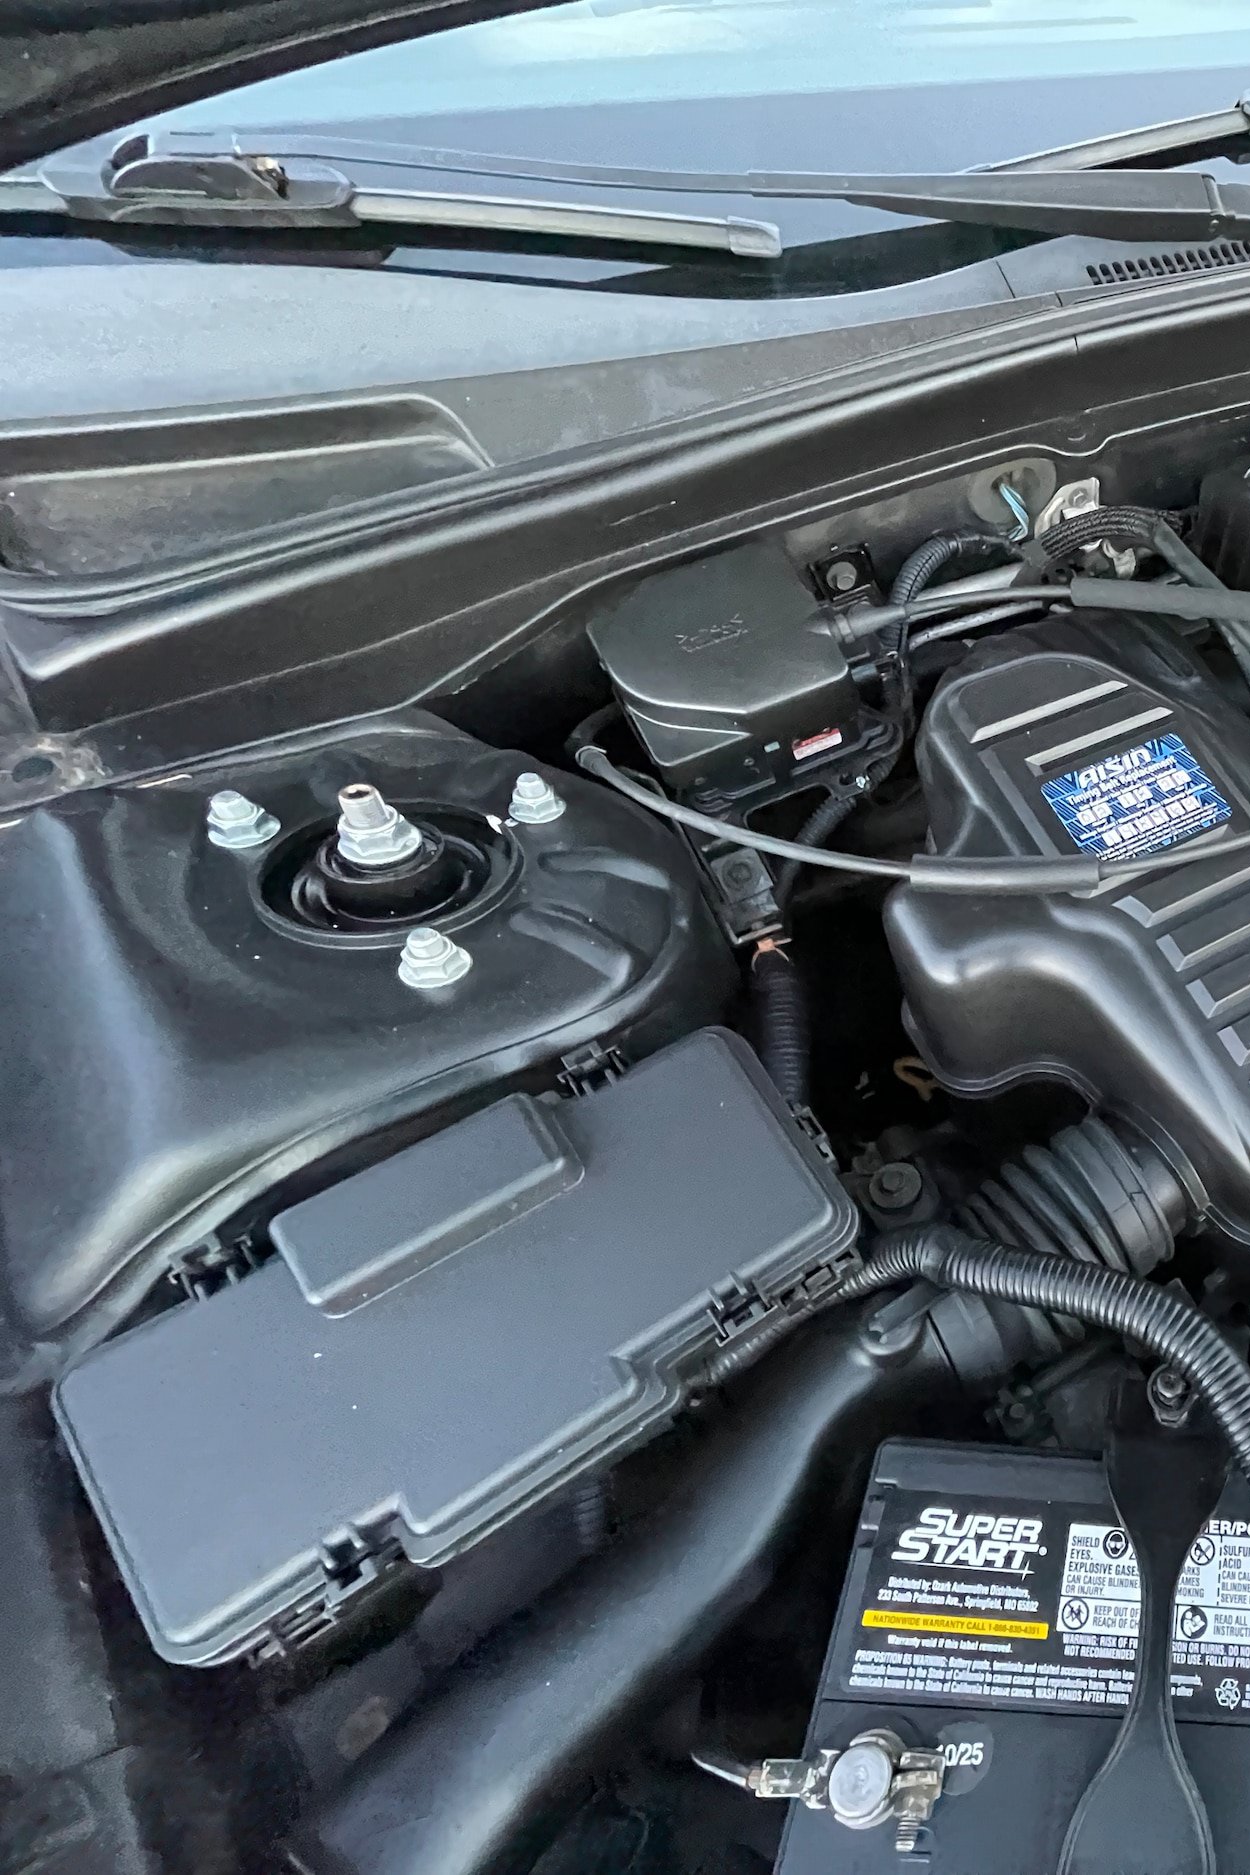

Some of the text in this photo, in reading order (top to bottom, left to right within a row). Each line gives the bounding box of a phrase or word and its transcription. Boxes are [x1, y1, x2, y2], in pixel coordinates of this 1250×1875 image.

[1079, 749, 1151, 789] AISIN
[1066, 786, 1101, 806] Timing
[1100, 777, 1121, 794] Belt
[1119, 755, 1177, 787] Replacement
[915, 1507, 1043, 1543] SUPER
[891, 1529, 1040, 1569] START
[1071, 1536, 1100, 1548] SHIELD
[1070, 1548, 1093, 1560] EYES.
[1068, 1561, 1113, 1575] EXPLOSIVE
[1222, 1557, 1241, 1569] ACID
[1067, 1574, 1140, 1588] CAN CAUSE BLINDNE
[1222, 1570, 1236, 1580] CAN
[888, 1576, 921, 1590] Distributed
[952, 1582, 988, 1595] Automotive
[1065, 1584, 1105, 1596] OR INJURY.
[878, 1589, 892, 1600] 233
[892, 1590, 912, 1602] South
[964, 1596, 1002, 1611] Springfield,
[1004, 1599, 1016, 1611] MO
[1220, 1593, 1247, 1604] SEVERE
[1093, 1605, 1140, 1618] KEEP OUT OF
[873, 1614, 921, 1626] NATIONWIDE
[922, 1618, 965, 1630] WARRANTY
[967, 1620, 985, 1631] CALL
[1093, 1616, 1117, 1628] REACH
[1118, 1617, 1128, 1628] OF
[1214, 1613, 1248, 1626] READ ALL
[888, 1634, 920, 1648] Warranty
[921, 1638, 937, 1648] void
[945, 1639, 958, 1649] this
[959, 1640, 978, 1650] label
[979, 1643, 1013, 1653] removed.
[1063, 1633, 1099, 1646] WARNING:
[1100, 1636, 1118, 1647] RISK
[1118, 1637, 1128, 1648] OF
[1064, 1645, 1135, 1660] NOT RECOMMENDED
[1188, 1642, 1200, 1653] OR
[1200, 1643, 1227, 1655] BURNS.
[1228, 1645, 1239, 1656] DO
[1187, 1654, 1203, 1665] USE.
[1205, 1655, 1235, 1668] FOLLOW
[1035, 1687, 1057, 1700] WASH
[1057, 1689, 1082, 1701] HANDS
[1082, 1690, 1106, 1703] AFTER
